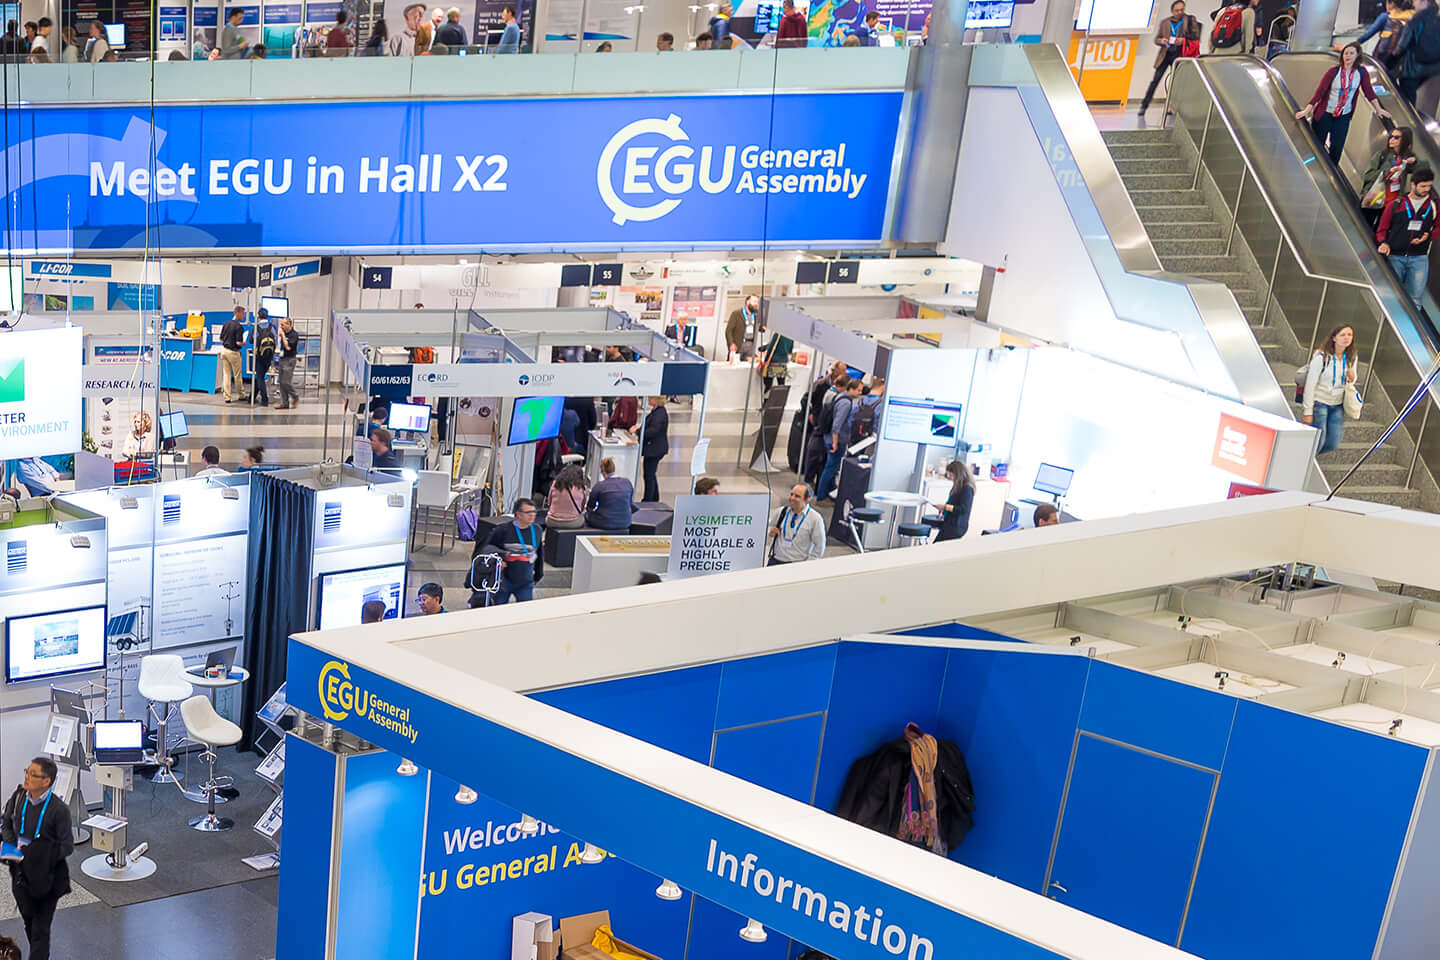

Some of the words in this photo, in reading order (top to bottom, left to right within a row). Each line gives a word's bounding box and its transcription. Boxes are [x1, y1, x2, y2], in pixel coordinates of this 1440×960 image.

[1079, 40, 1126, 66] PICO
[88, 158, 196, 197] Meet
[208, 158, 293, 196] EGU
[306, 154, 345, 195] in
[360, 153, 441, 193] Hall
[451, 154, 509, 192] X2
[624, 144, 736, 195] EGU
[740, 143, 845, 171] General
[736, 167, 867, 200] Assembly
[39, 263, 74, 275] LI-COR
[602, 270, 612, 279] 55
[838, 267, 849, 277] 56
[372, 273, 383, 282] 54
[84, 379, 138, 391] RESEARCH,
[139, 380, 156, 390] Inc.
[371, 374, 411, 386] 60/61/62/63
[531, 374, 555, 384] IODP
[685, 514, 753, 526] LYSIMETER
[683, 526, 718, 537] MOST
[682, 538, 743, 549] VALUABLE
[746, 538, 755, 548] &
[681, 549, 726, 560] HIGHLY
[679, 560, 731, 571] PRECISE
[325, 675, 369, 718] EGU
[368, 693, 410, 723] General
[367, 707, 419, 745] Assembly
[443, 821, 561, 855] Welco
[456, 845, 558, 890] General
